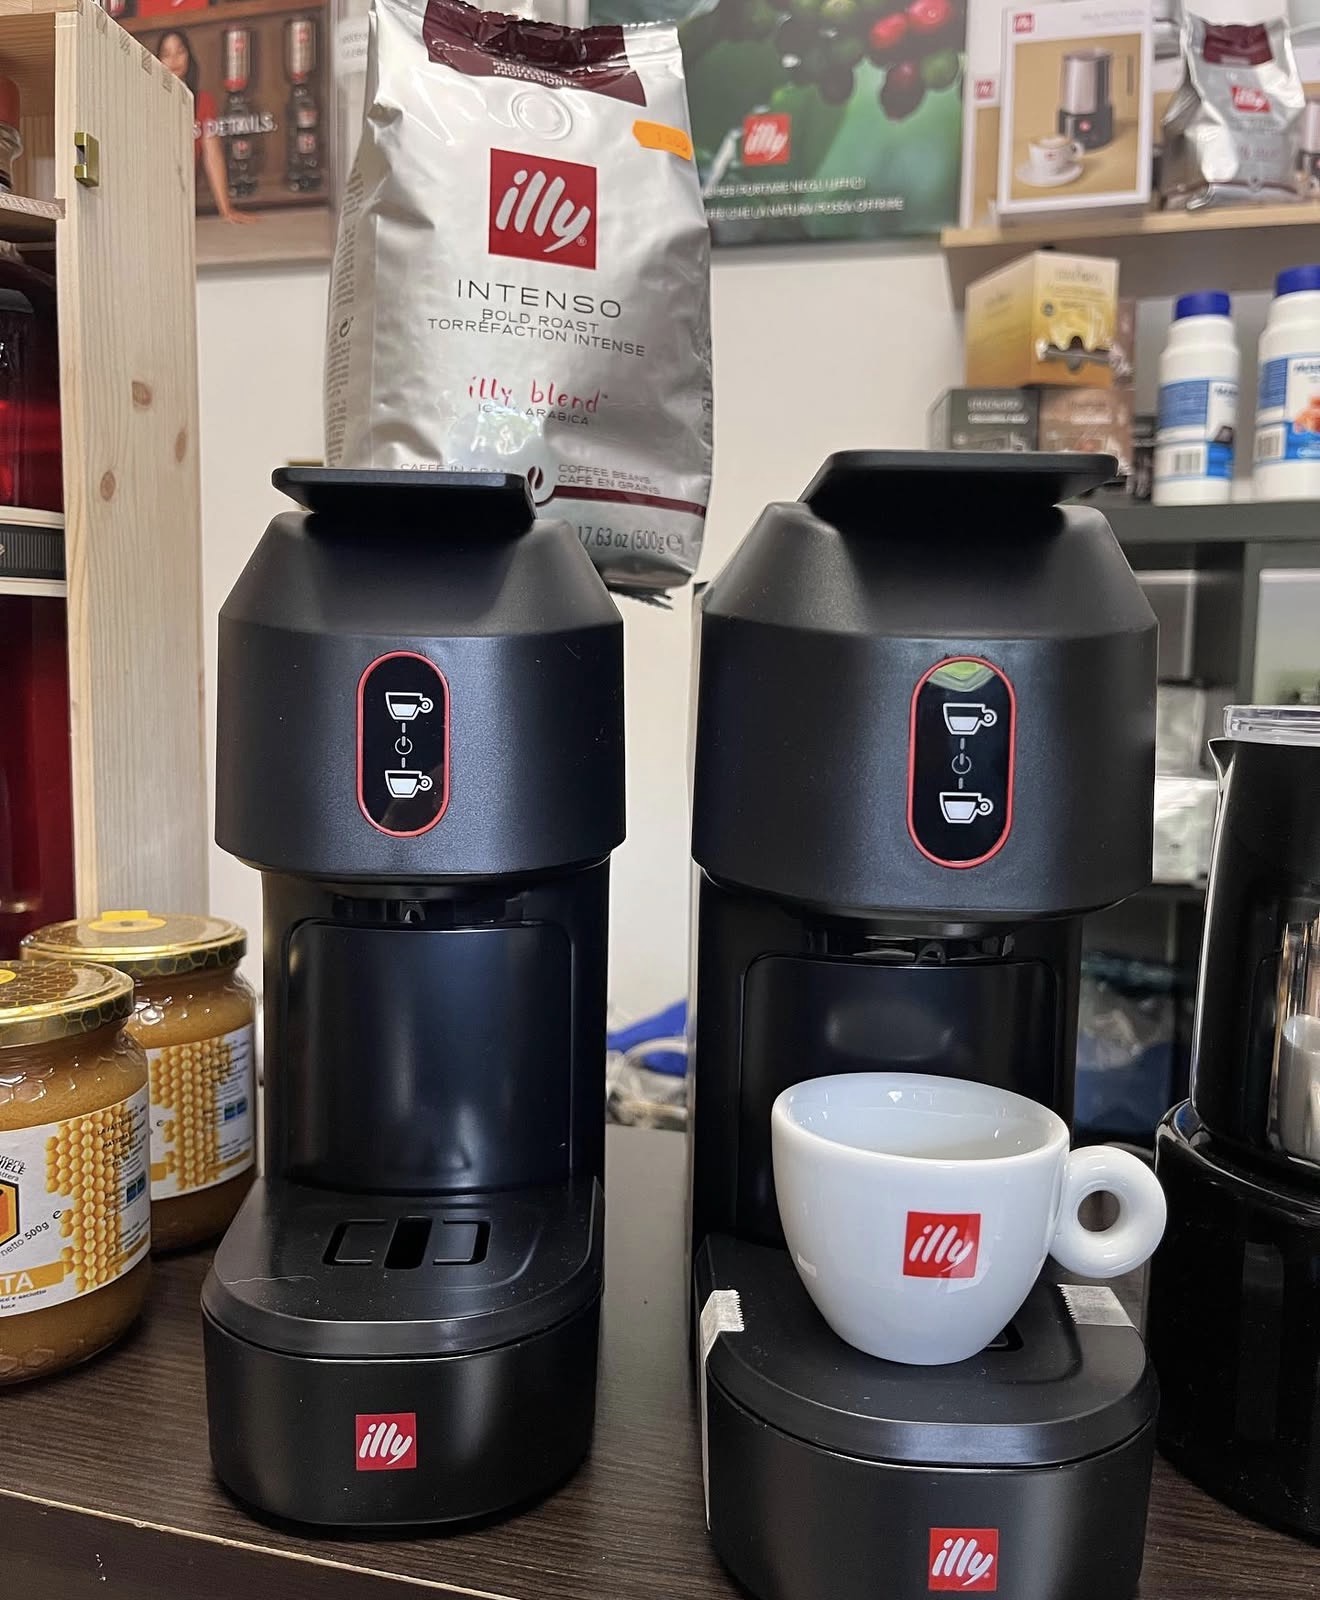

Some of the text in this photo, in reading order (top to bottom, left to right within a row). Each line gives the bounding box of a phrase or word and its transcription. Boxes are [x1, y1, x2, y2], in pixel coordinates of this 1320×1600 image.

[745, 121, 788, 160] illy
[495, 169, 591, 253] illy
[457, 279, 621, 319] INTENSO
[428, 318, 645, 357] TORRÉFACTION INTENSE
[482, 308, 600, 334] BOLD ROAST
[468, 376, 513, 406] illy
[525, 407, 589, 426] ARABICA
[558, 463, 651, 485] COFFEE BEANS
[558, 474, 593, 486] CAFÉ
[597, 477, 616, 488] EN
[577, 525, 612, 547] 17.63
[614, 533, 628, 549] oz
[0, 1239, 24, 1256] netto
[24, 1221, 50, 1240] 500g
[909, 1224, 973, 1273] illy
[359, 1422, 413, 1466] illy
[932, 1537, 994, 1587] illy
